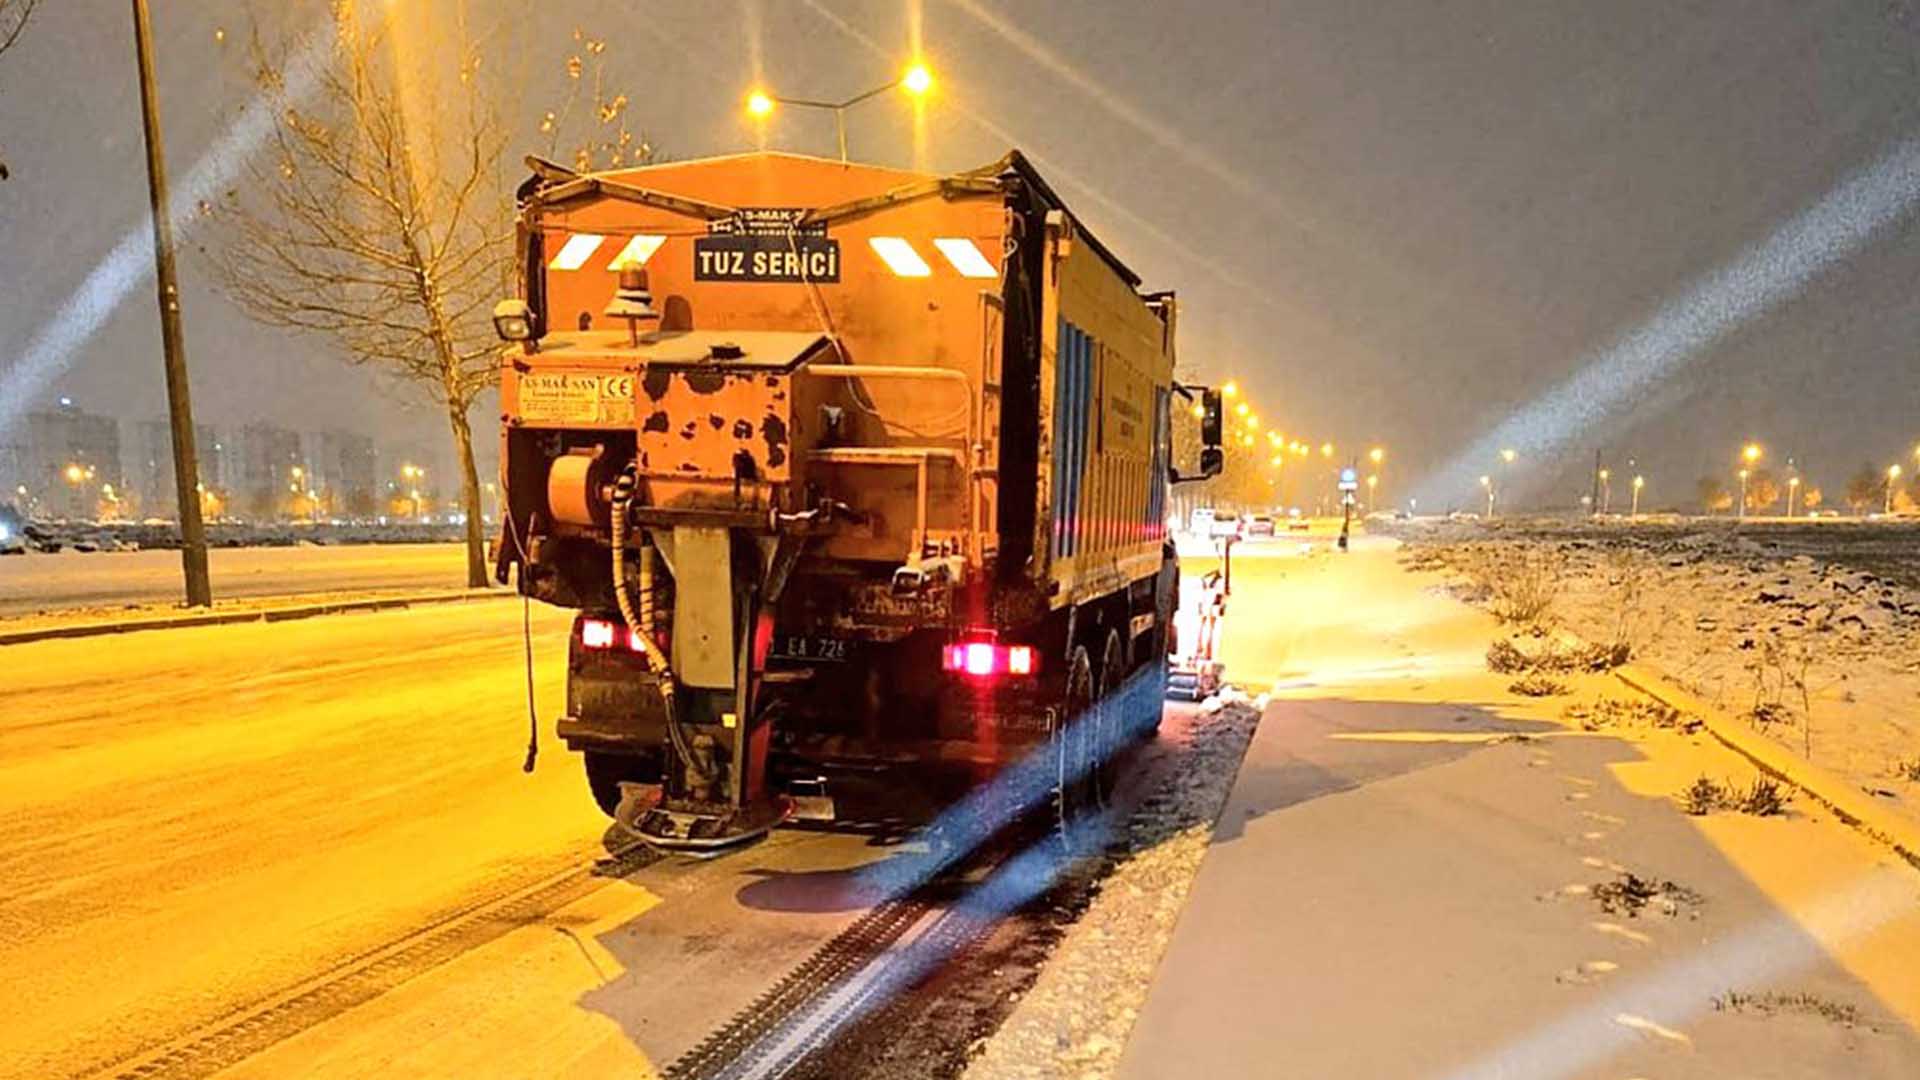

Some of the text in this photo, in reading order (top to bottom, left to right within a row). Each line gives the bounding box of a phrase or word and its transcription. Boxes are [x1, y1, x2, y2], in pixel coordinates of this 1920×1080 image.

[699, 246, 836, 276] TUZ SERİCİ
[606, 378, 629, 397] CE
